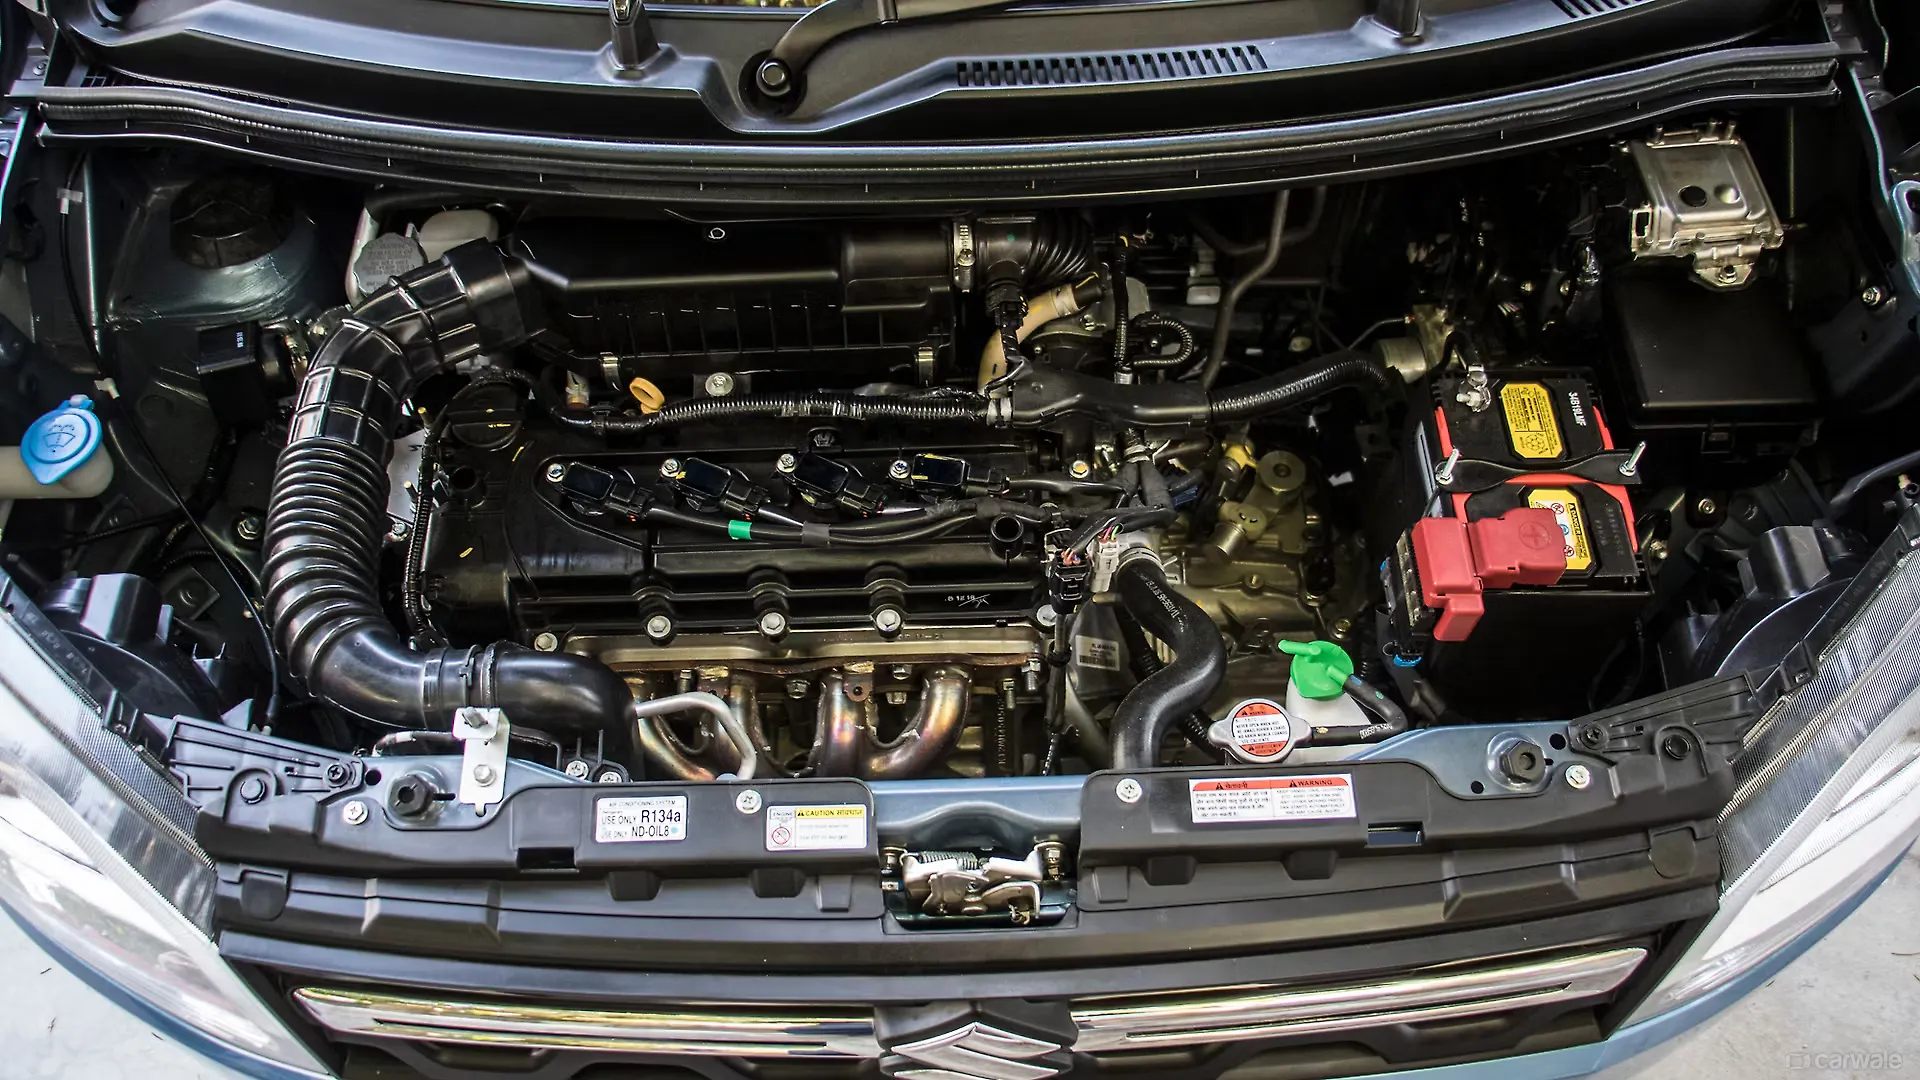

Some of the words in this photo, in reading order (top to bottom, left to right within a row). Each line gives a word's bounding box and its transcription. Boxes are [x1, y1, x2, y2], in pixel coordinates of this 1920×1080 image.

[601, 815, 616, 824] USE
[618, 815, 637, 824] ONLY
[641, 809, 681, 823] R134a
[631, 825, 670, 837] ND-OIL8
